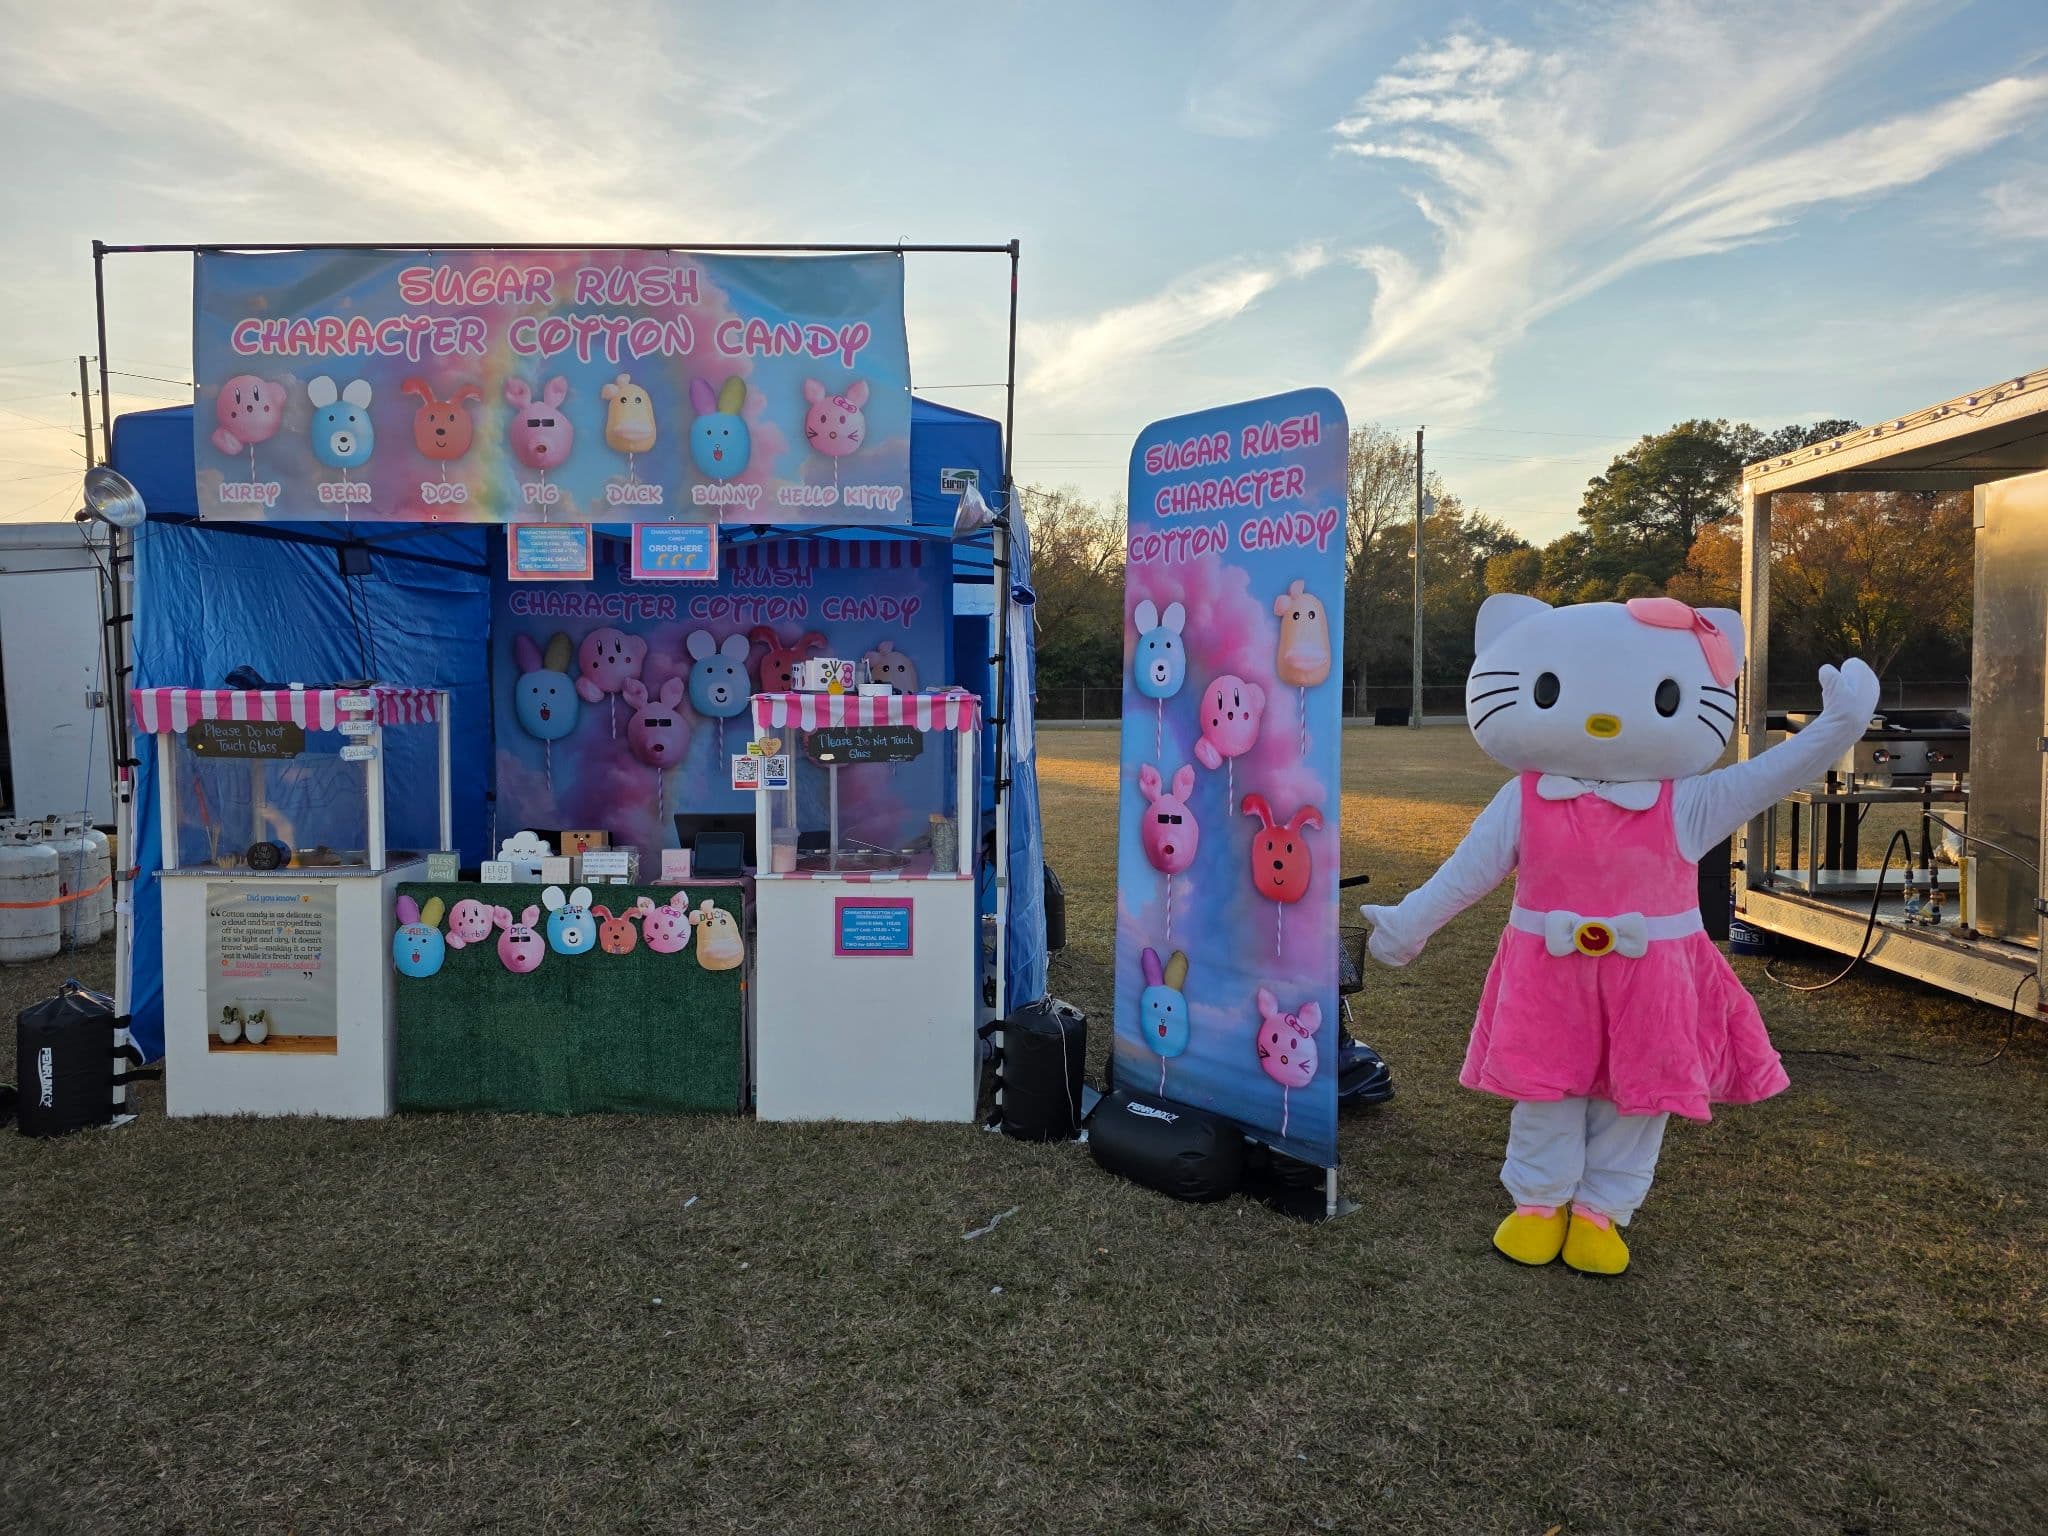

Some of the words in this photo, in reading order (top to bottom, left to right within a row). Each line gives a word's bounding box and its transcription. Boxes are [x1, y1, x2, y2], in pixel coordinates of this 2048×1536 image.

[398, 264, 553, 306] SUGAR
[576, 266, 700, 306] RUSH
[231, 314, 487, 362] CHARACTER
[509, 313, 695, 363] COTTON
[714, 318, 871, 369] CANDY
[1145, 431, 1230, 476] SUGAR
[1241, 411, 1320, 458] RUSH
[219, 481, 281, 507] KIRBY
[318, 481, 372, 503] BEAR
[421, 481, 467, 503] DOG
[523, 482, 560, 504] PIG
[606, 483, 663, 506] DUCK
[691, 483, 762, 510] BUNNY
[941, 478, 976, 489] Eurmx
[1155, 465, 1305, 517] CHARACTER
[777, 485, 838, 508] HELLO
[843, 485, 903, 511] KITTY
[1128, 520, 1228, 565] COTTON
[1240, 507, 1338, 553] CANDY
[732, 567, 813, 588] RUSH
[509, 590, 676, 624] CHARACTER
[689, 593, 808, 625] COTTON
[820, 595, 922, 629] CANDY
[204, 723, 241, 737] Please
[245, 725, 261, 737] Do
[216, 740, 246, 752] Touch
